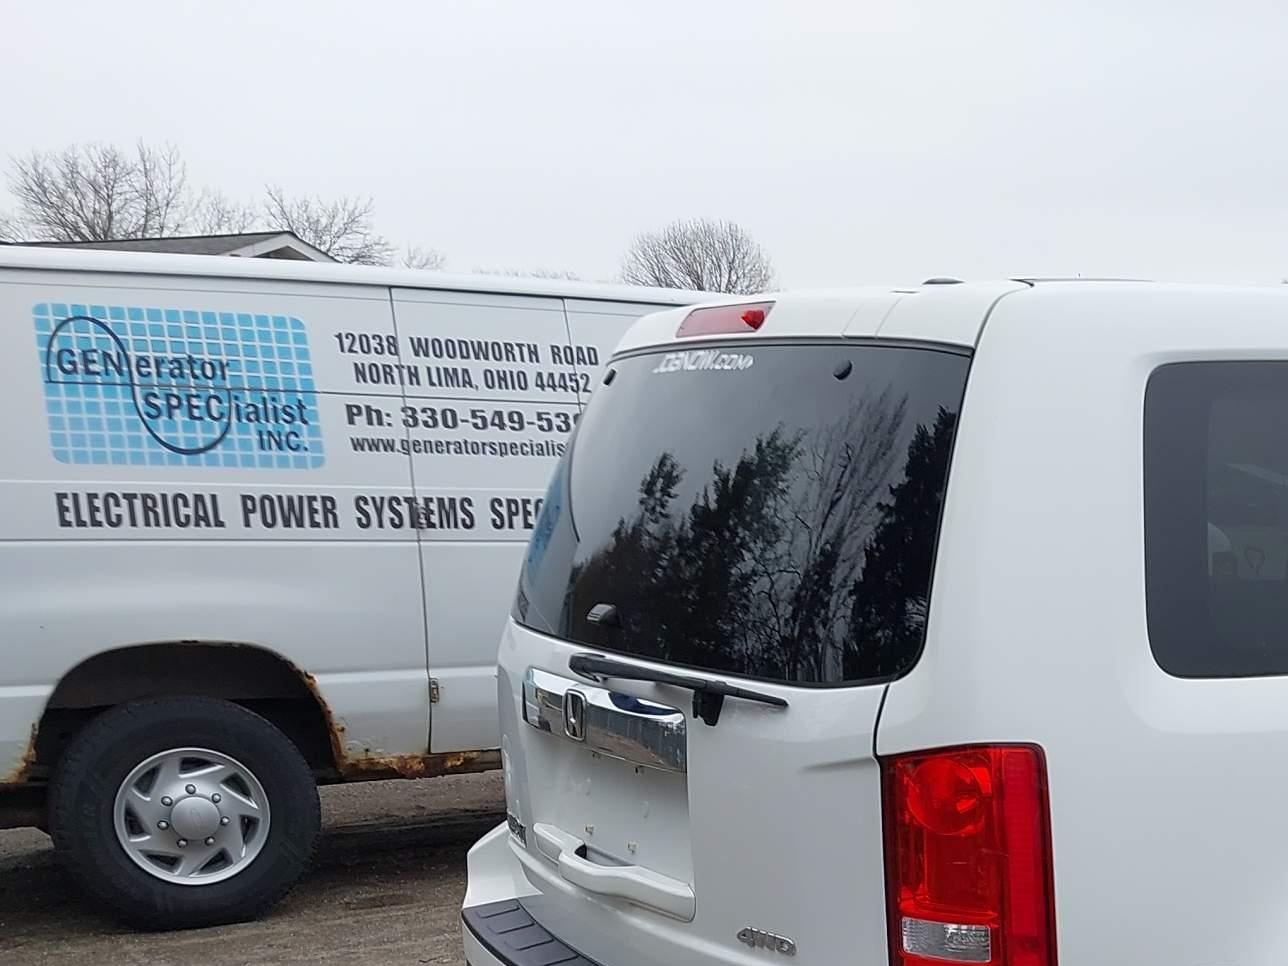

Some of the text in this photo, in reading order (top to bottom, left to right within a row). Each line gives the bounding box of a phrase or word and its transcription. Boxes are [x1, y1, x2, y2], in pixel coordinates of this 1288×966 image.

[56, 349, 230, 381] GENerator
[335, 332, 600, 366] 12038 WOODWORTH ROAD
[353, 362, 593, 394] NORTH LIMA, OHIO 44452
[144, 393, 309, 426] SPECialist
[345, 403, 393, 428] Ph:
[258, 431, 310, 452] INC.
[350, 437, 569, 459] www.generatorspecialis
[55, 492, 225, 529] ELECTRICAL
[240, 494, 340, 529] POWER
[355, 495, 476, 531] SYSTEMS
